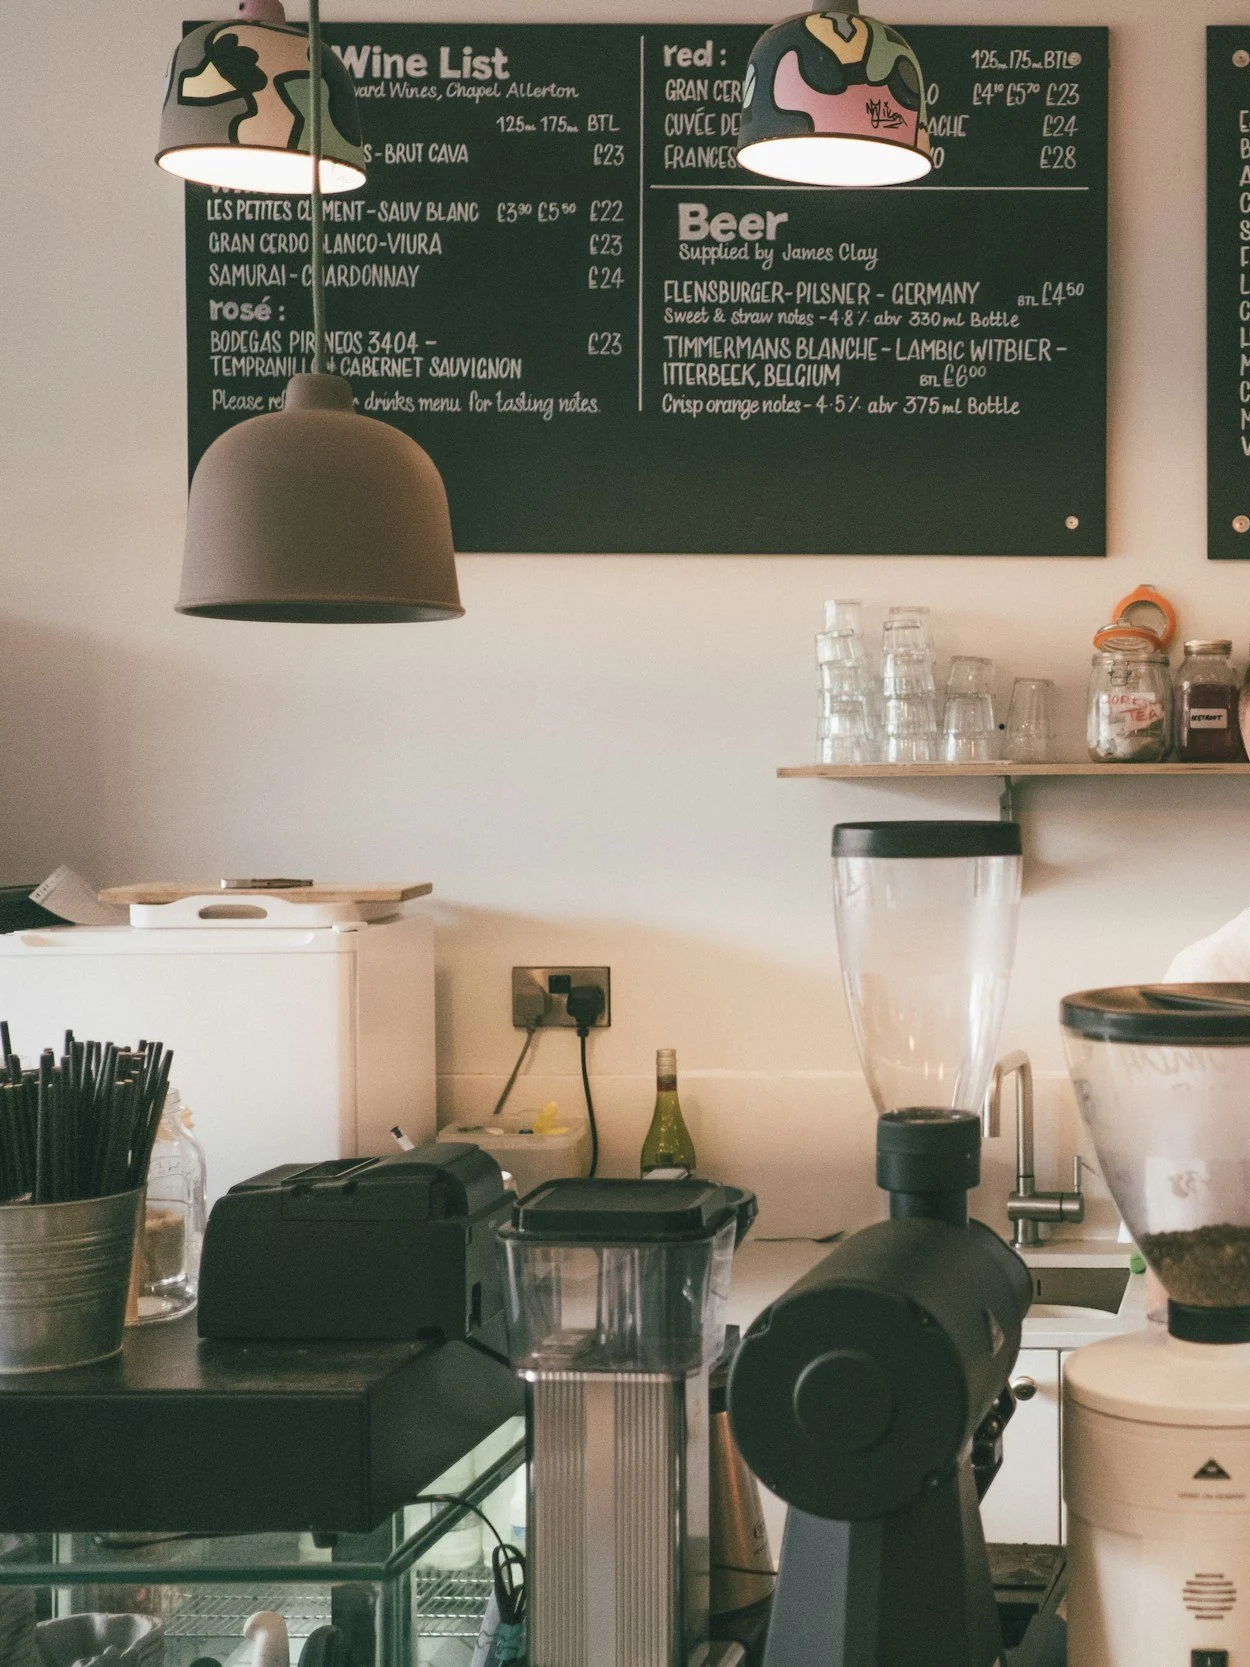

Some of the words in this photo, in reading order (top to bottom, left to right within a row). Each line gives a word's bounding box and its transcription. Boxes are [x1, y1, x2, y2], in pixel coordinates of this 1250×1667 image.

[331, 46, 427, 78] Wine
[440, 46, 509, 80] List
[389, 82, 442, 101] Wines,
[446, 82, 501, 104] Chapel
[506, 82, 579, 98] Allerton
[665, 78, 708, 101] GRAN
[1046, 83, 1079, 106] £23
[588, 114, 619, 131] BTL
[665, 107, 715, 136] CUVÉE
[1043, 115, 1078, 137] £24
[428, 143, 468, 163] CAVA
[594, 144, 624, 166] £23
[1040, 145, 1076, 169] £28
[207, 199, 232, 220] LES
[237, 199, 292, 221] PETITES
[426, 202, 479, 222] BLANC
[590, 200, 624, 222] £22
[679, 203, 788, 246] Beer
[209, 232, 254, 253] GRAN
[260, 233, 309, 254] CERDO
[590, 234, 622, 256] £23
[679, 239, 749, 265] Supplied
[755, 243, 773, 270] by
[782, 243, 834, 261] James
[839, 243, 878, 271] Clay
[209, 263, 286, 286] SAMURAI
[302, 264, 419, 288] CARDONNAY
[588, 266, 624, 289] £24
[797, 281, 870, 305] PILSNER
[892, 282, 980, 306] GERMANY
[664, 307, 709, 324] Sweet
[713, 308, 727, 325] &
[731, 308, 773, 325] straw
[778, 309, 814, 326] notes
[874, 310, 902, 325] abv
[971, 311, 1019, 327] Bottle
[211, 330, 282, 353] BODEGAS
[290, 330, 362, 354] PIRNEOS
[368, 331, 418, 354] 3404
[588, 332, 622, 355] £23
[664, 335, 791, 359] TIMMERMANS
[796, 337, 878, 361] BLANCHE
[896, 338, 964, 361] LAMBIC
[971, 338, 1051, 362] WITBIER
[340, 356, 423, 377] CABERNET
[429, 357, 521, 379] SAUVIGNON
[764, 364, 840, 387] BELGIUM
[212, 389, 264, 410] Please
[364, 391, 415, 412] drinks
[418, 398, 461, 412] menu
[469, 390, 492, 412] for
[496, 391, 554, 421] tasting
[662, 393, 703, 418] Crisp
[706, 399, 759, 420] orange
[762, 394, 801, 413] notes
[868, 395, 897, 413] abv
[968, 396, 1020, 415] Bottle
